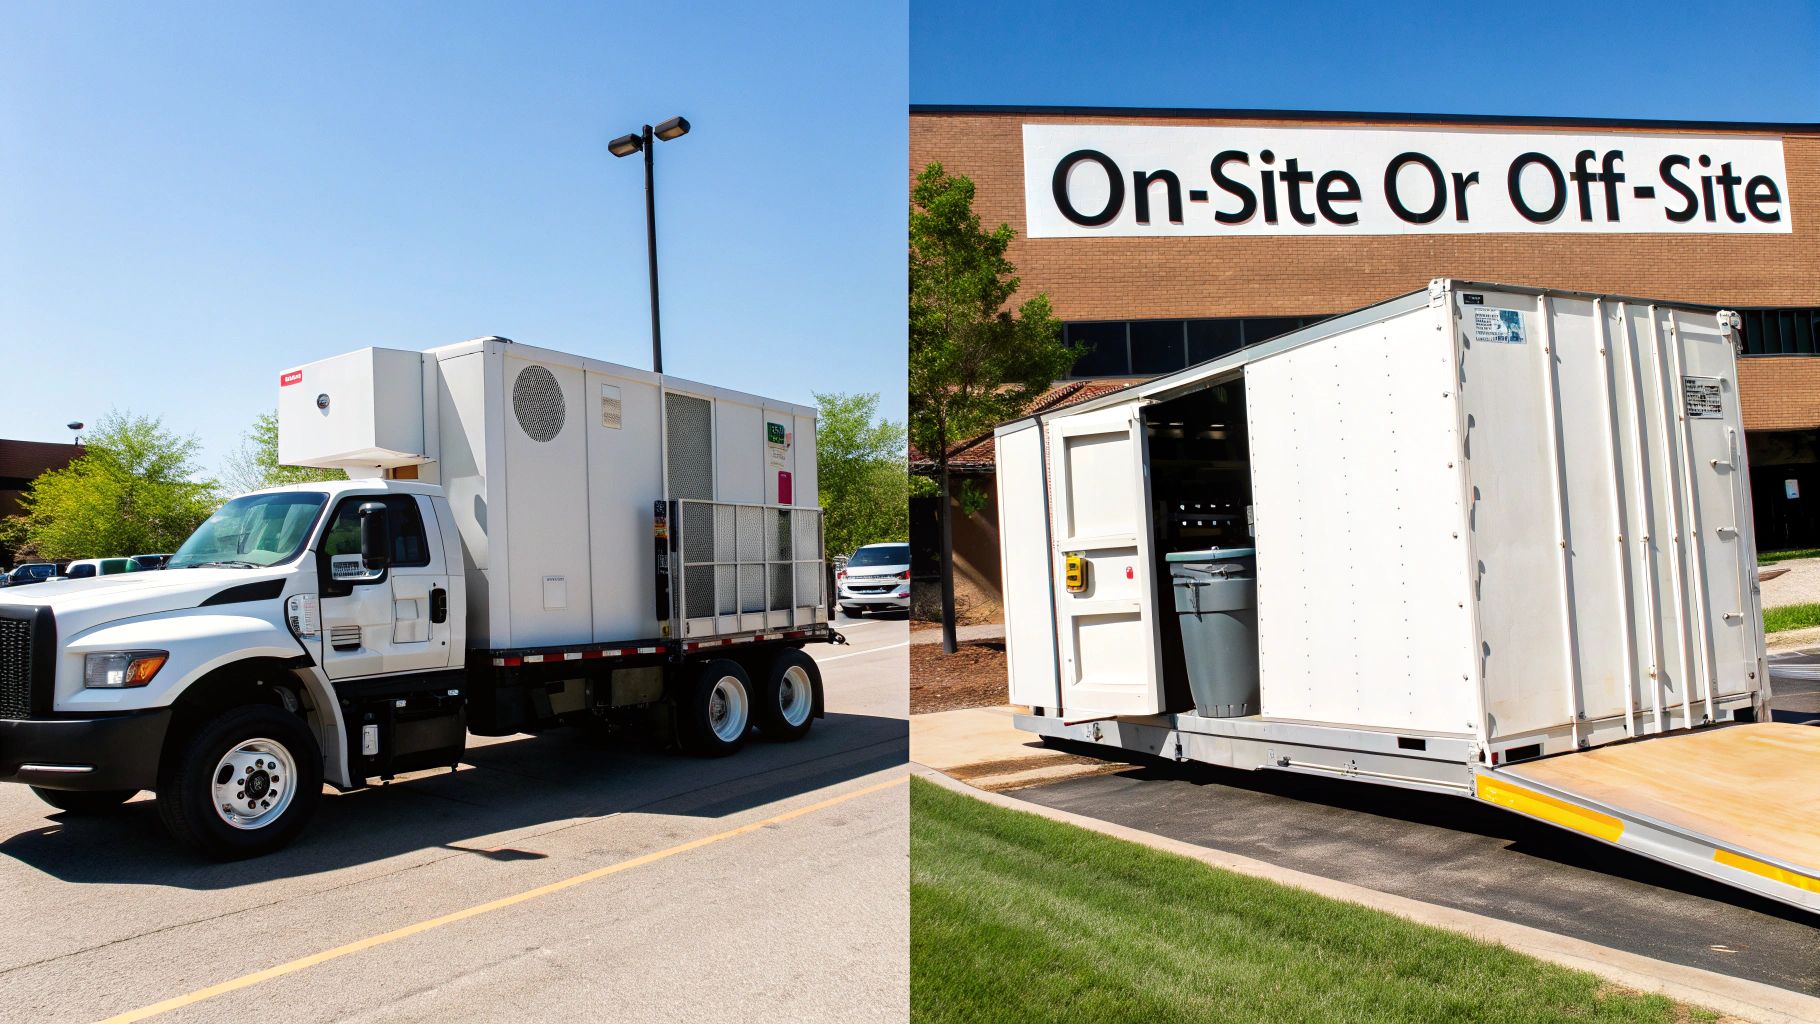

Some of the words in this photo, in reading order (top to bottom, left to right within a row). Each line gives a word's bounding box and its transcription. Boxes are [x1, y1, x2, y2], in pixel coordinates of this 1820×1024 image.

[1052, 149, 1362, 226] On-Site
[1383, 151, 1480, 224] Or
[1507, 149, 1782, 224] Off-Site
